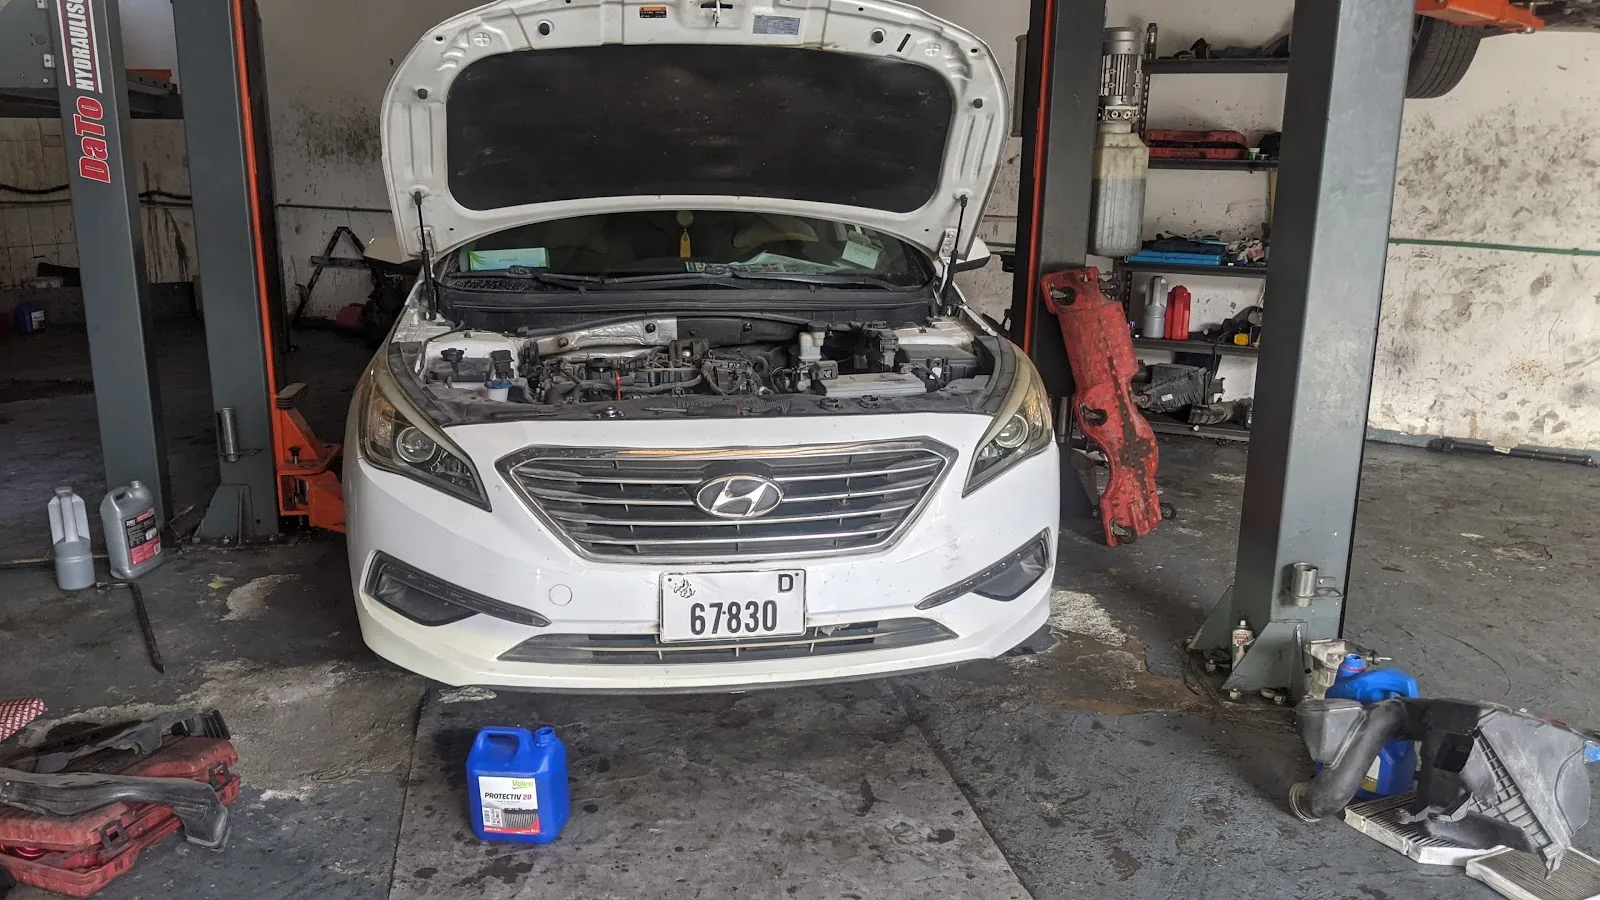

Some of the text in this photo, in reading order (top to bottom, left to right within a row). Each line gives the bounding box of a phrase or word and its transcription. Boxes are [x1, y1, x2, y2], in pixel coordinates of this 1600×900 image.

[778, 573, 794, 593] D
[690, 599, 778, 635] 67830
[512, 779, 533, 787] Valeo
[484, 792, 521, 800] PROTECTIV
